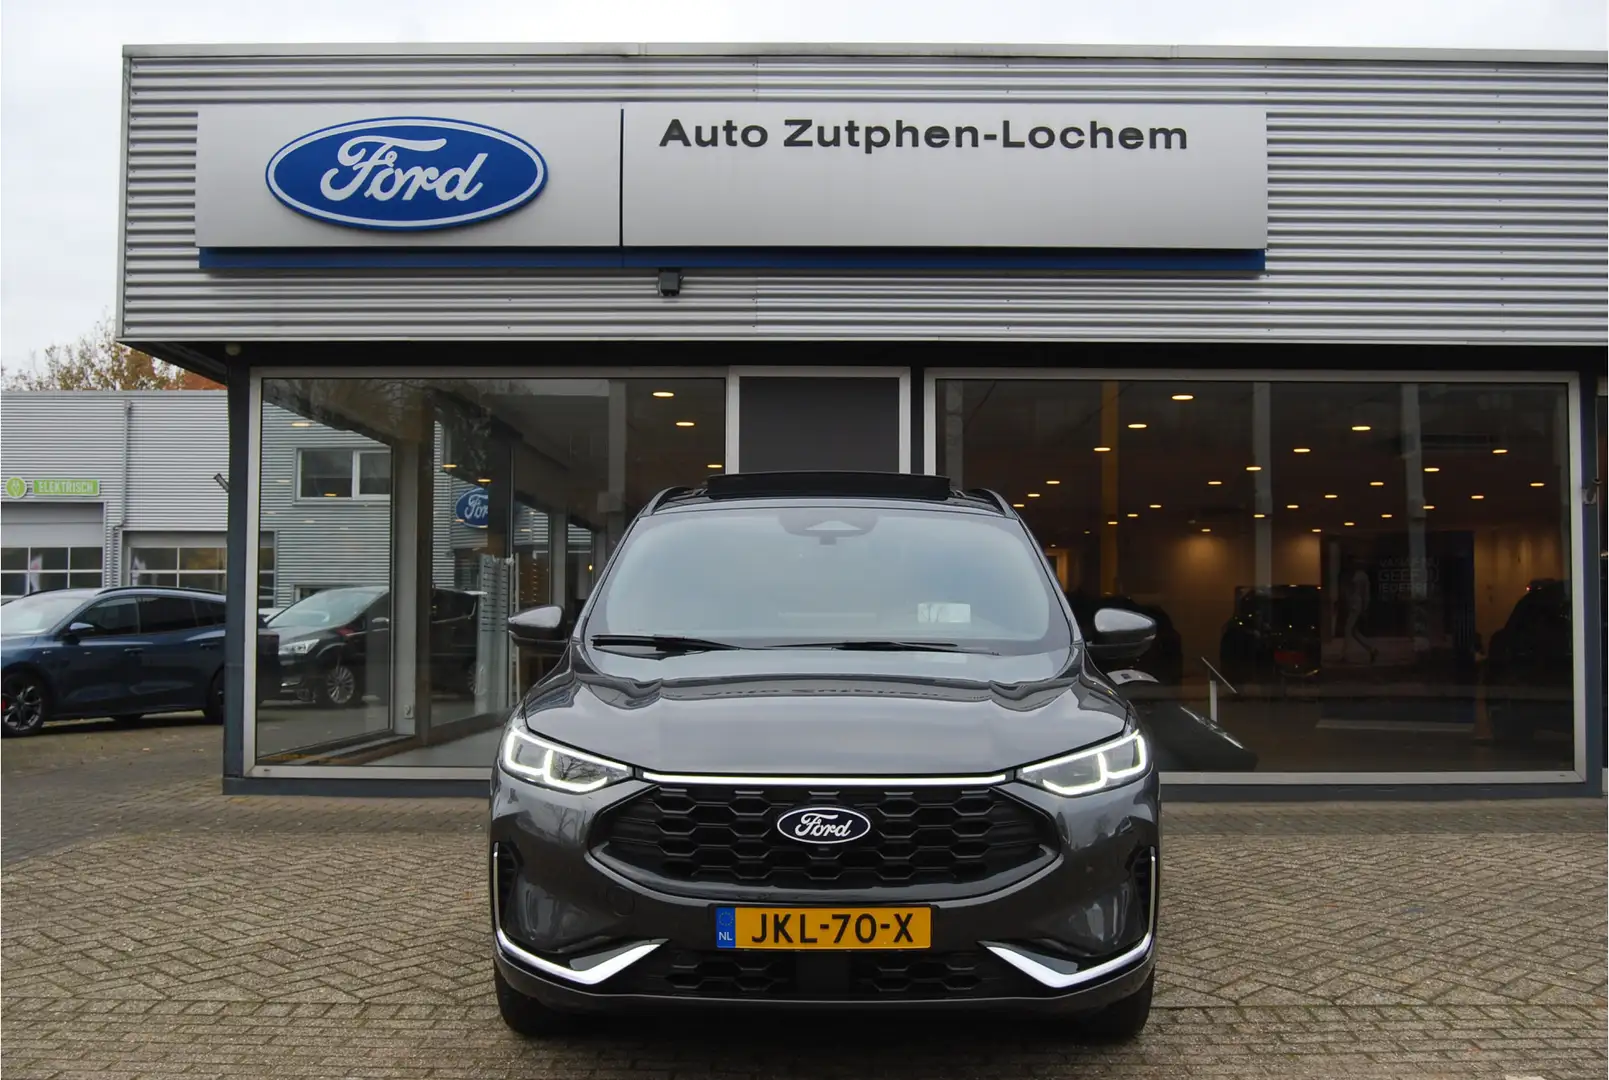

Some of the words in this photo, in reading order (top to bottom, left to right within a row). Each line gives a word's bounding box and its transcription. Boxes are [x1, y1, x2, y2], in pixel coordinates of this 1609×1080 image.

[659, 118, 769, 149] Auto
[783, 119, 1188, 155] Zutphen-Lochem
[319, 134, 489, 202] Ford
[39, 481, 93, 493] ELEKTRISCH
[464, 493, 489, 519] For
[794, 812, 853, 837] Ford
[719, 931, 733, 941] NL
[751, 912, 914, 944] JKL-70-X
